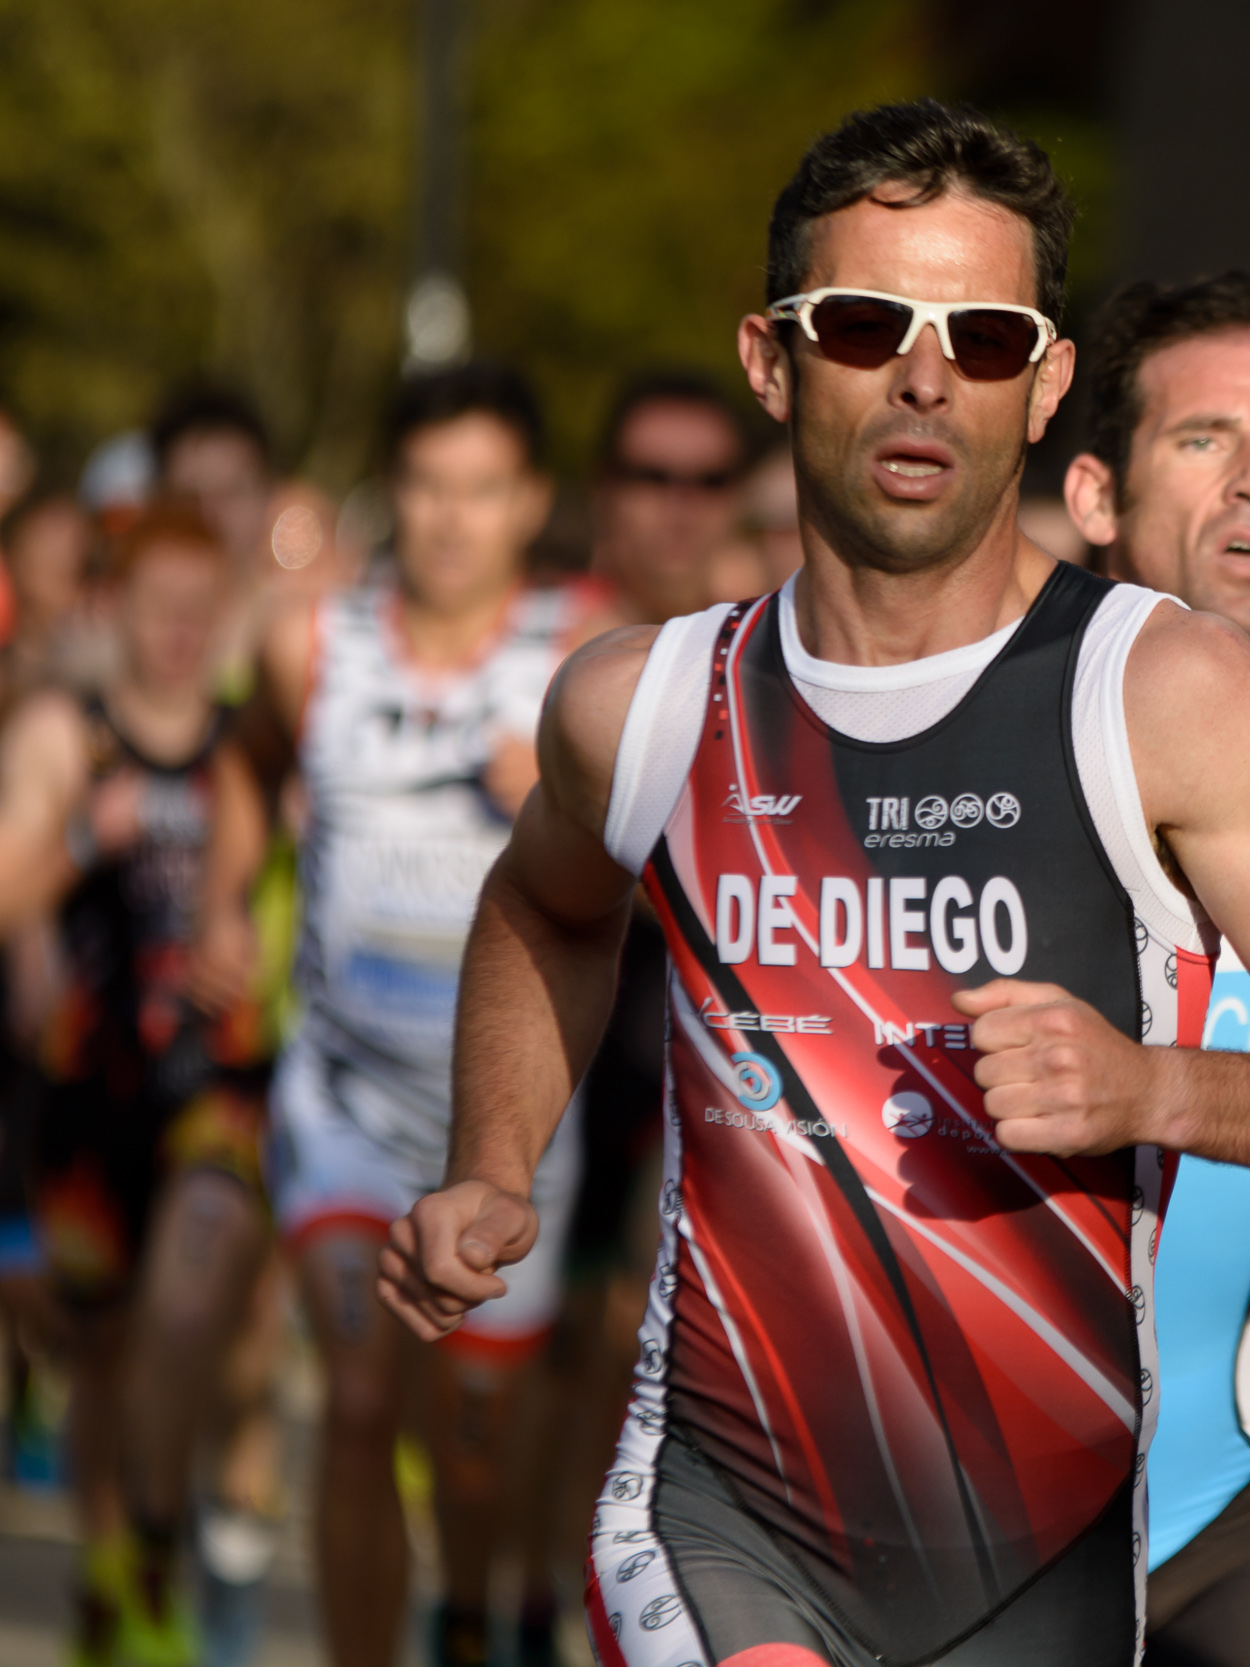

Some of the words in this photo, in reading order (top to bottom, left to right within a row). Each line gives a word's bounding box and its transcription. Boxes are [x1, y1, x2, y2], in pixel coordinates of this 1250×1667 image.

[866, 797, 910, 831] TRI
[864, 832, 956, 849] eresma
[717, 873, 797, 966] DE
[819, 875, 1029, 976] DIEGO
[873, 1021, 976, 1050] INTE
